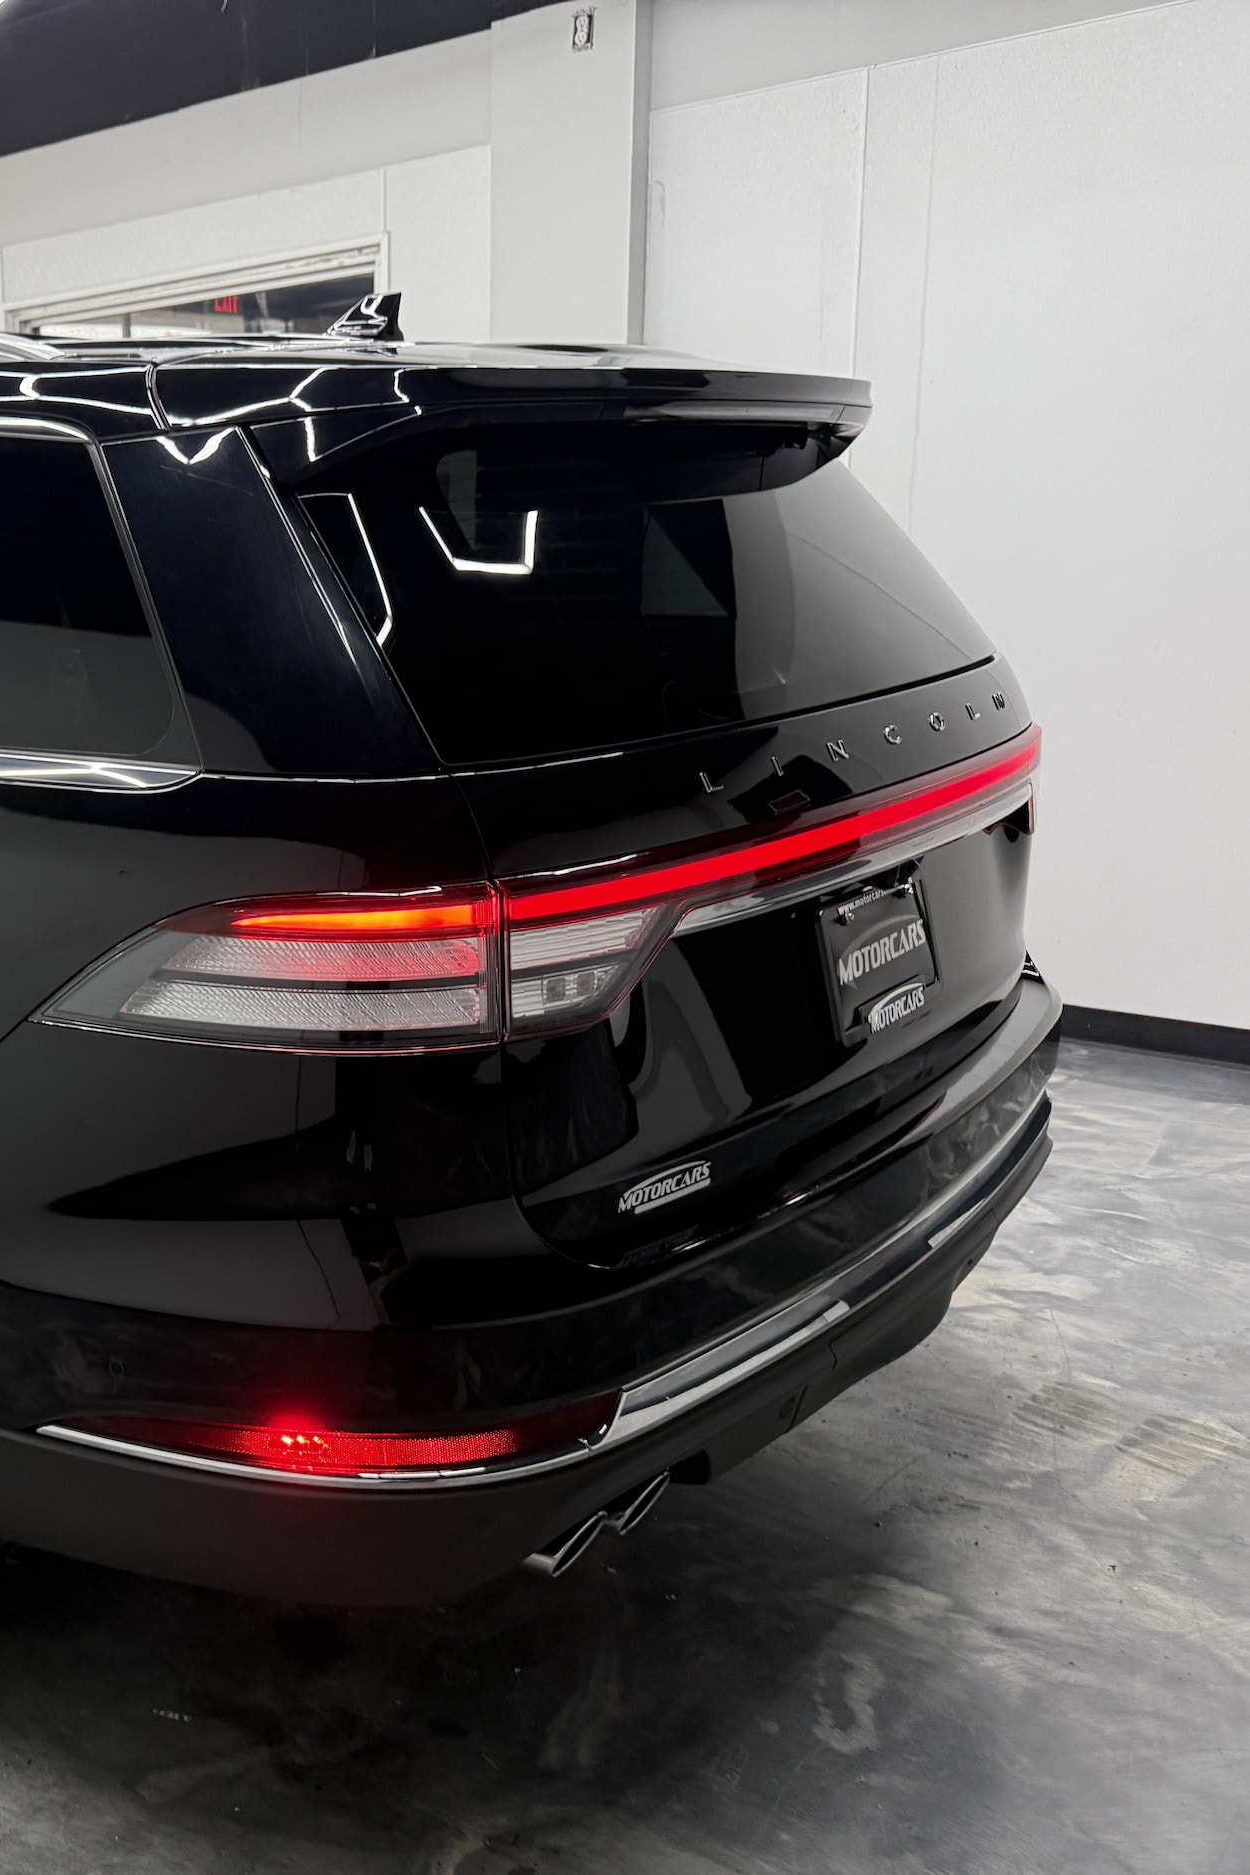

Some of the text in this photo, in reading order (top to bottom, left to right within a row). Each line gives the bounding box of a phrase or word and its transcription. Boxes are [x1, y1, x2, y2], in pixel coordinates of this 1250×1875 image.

[699, 692, 1006, 794] LINCOLN
[838, 918, 925, 986] MOTORCARS
[870, 987, 925, 1034] MOTORCARS
[617, 1161, 711, 1213] MOTORCARS
